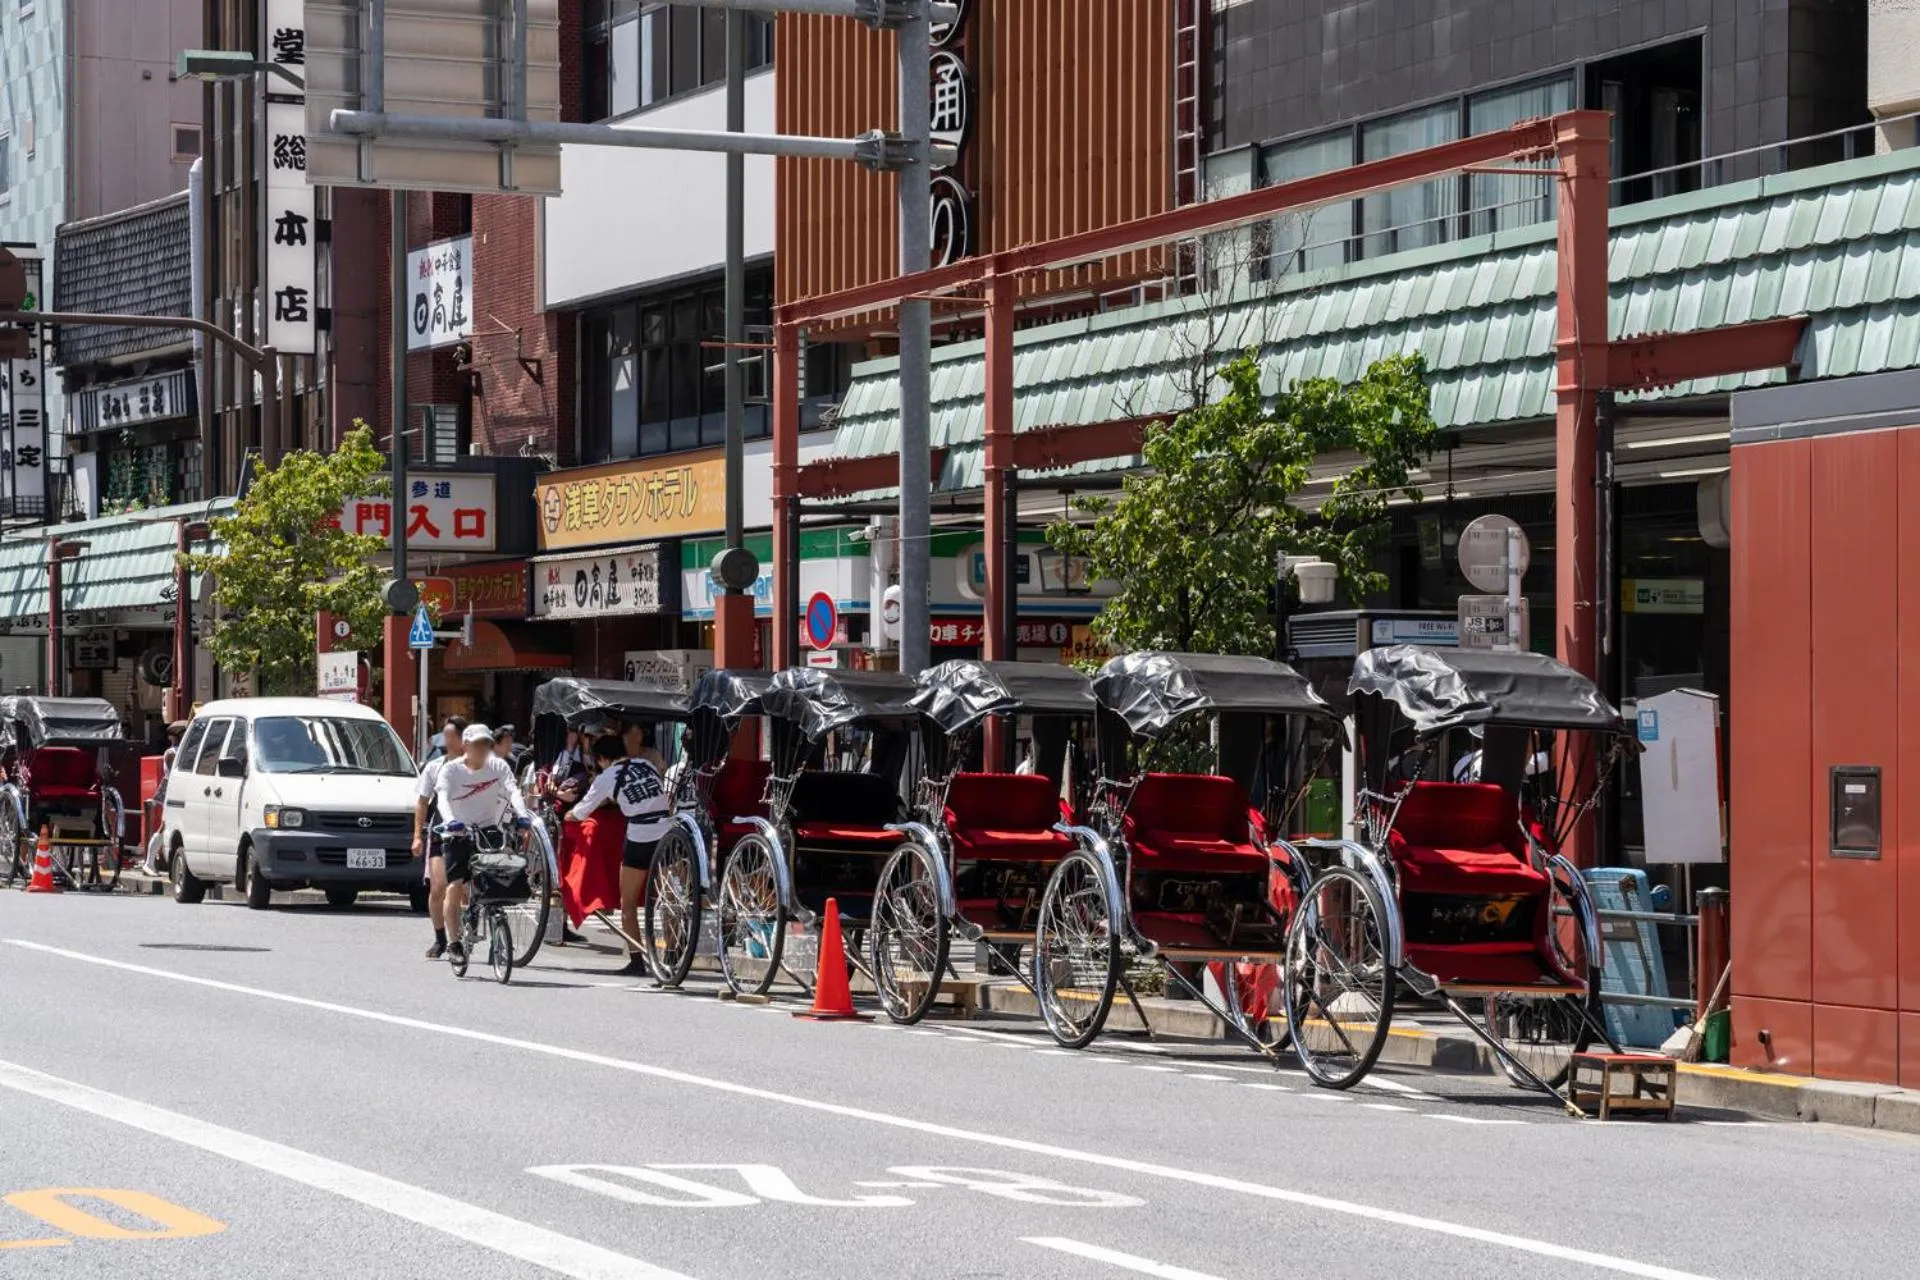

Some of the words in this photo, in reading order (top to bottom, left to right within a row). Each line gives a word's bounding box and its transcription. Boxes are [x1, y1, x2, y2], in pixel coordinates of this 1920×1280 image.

[414, 276, 467, 335] 日高屋
[565, 467, 698, 531] 浅草タウンホテル
[457, 573, 520, 601] 草タウンホテル
[575, 559, 621, 609] 日高屋
